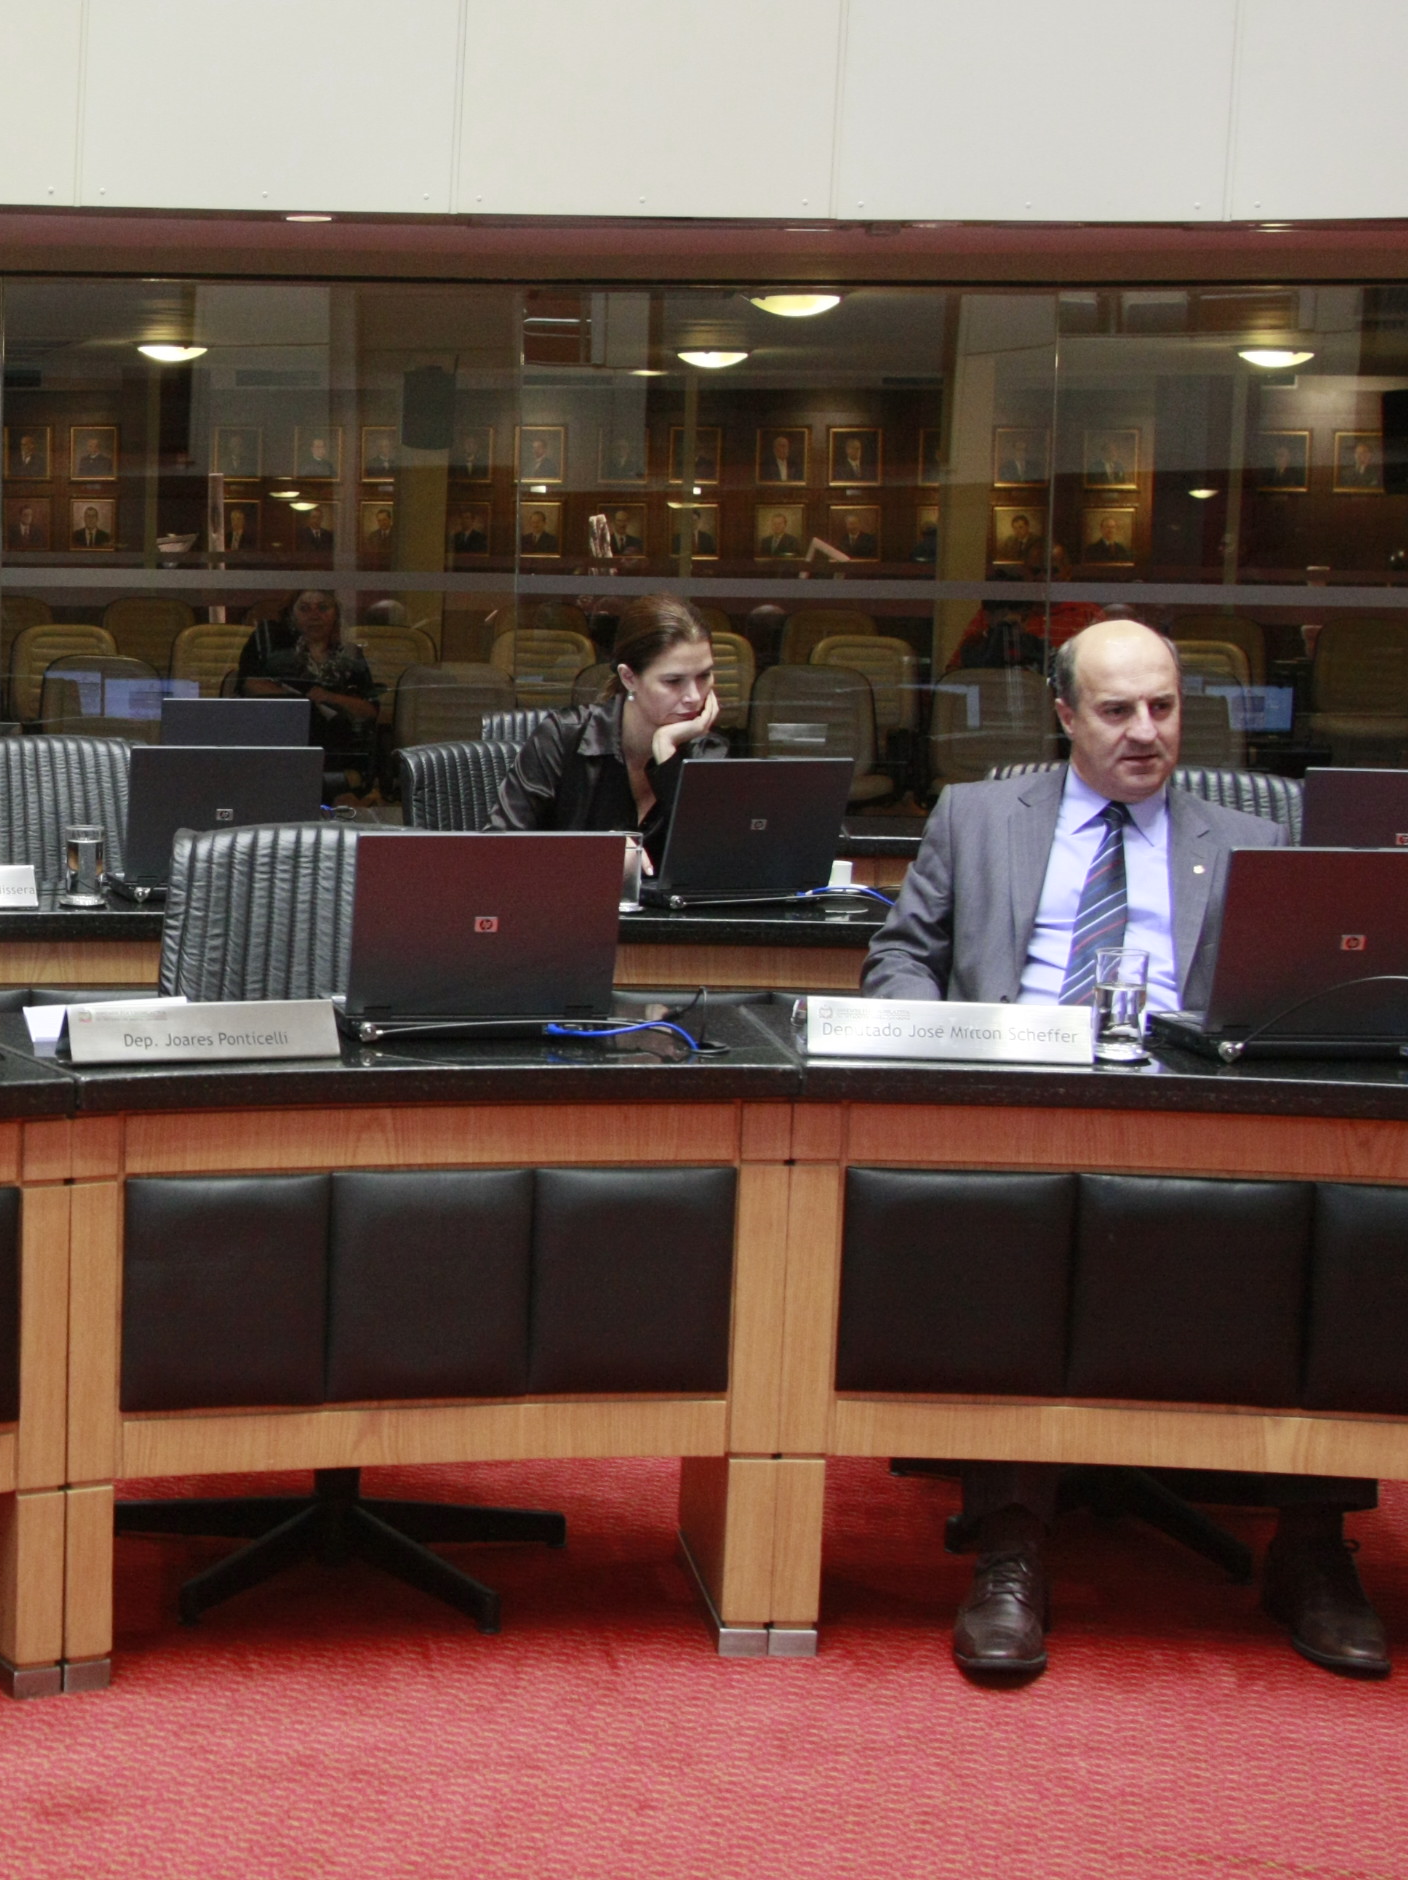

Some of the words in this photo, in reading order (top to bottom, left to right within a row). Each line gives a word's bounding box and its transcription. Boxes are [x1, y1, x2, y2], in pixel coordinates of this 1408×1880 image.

[123, 1033, 159, 1050] Dep.
[165, 1032, 214, 1047] Joares
[218, 1031, 289, 1046] Ponticelli
[822, 1021, 903, 1039] Deputado
[908, 1023, 945, 1039] José
[1008, 1027, 1080, 1043] Scheffer
